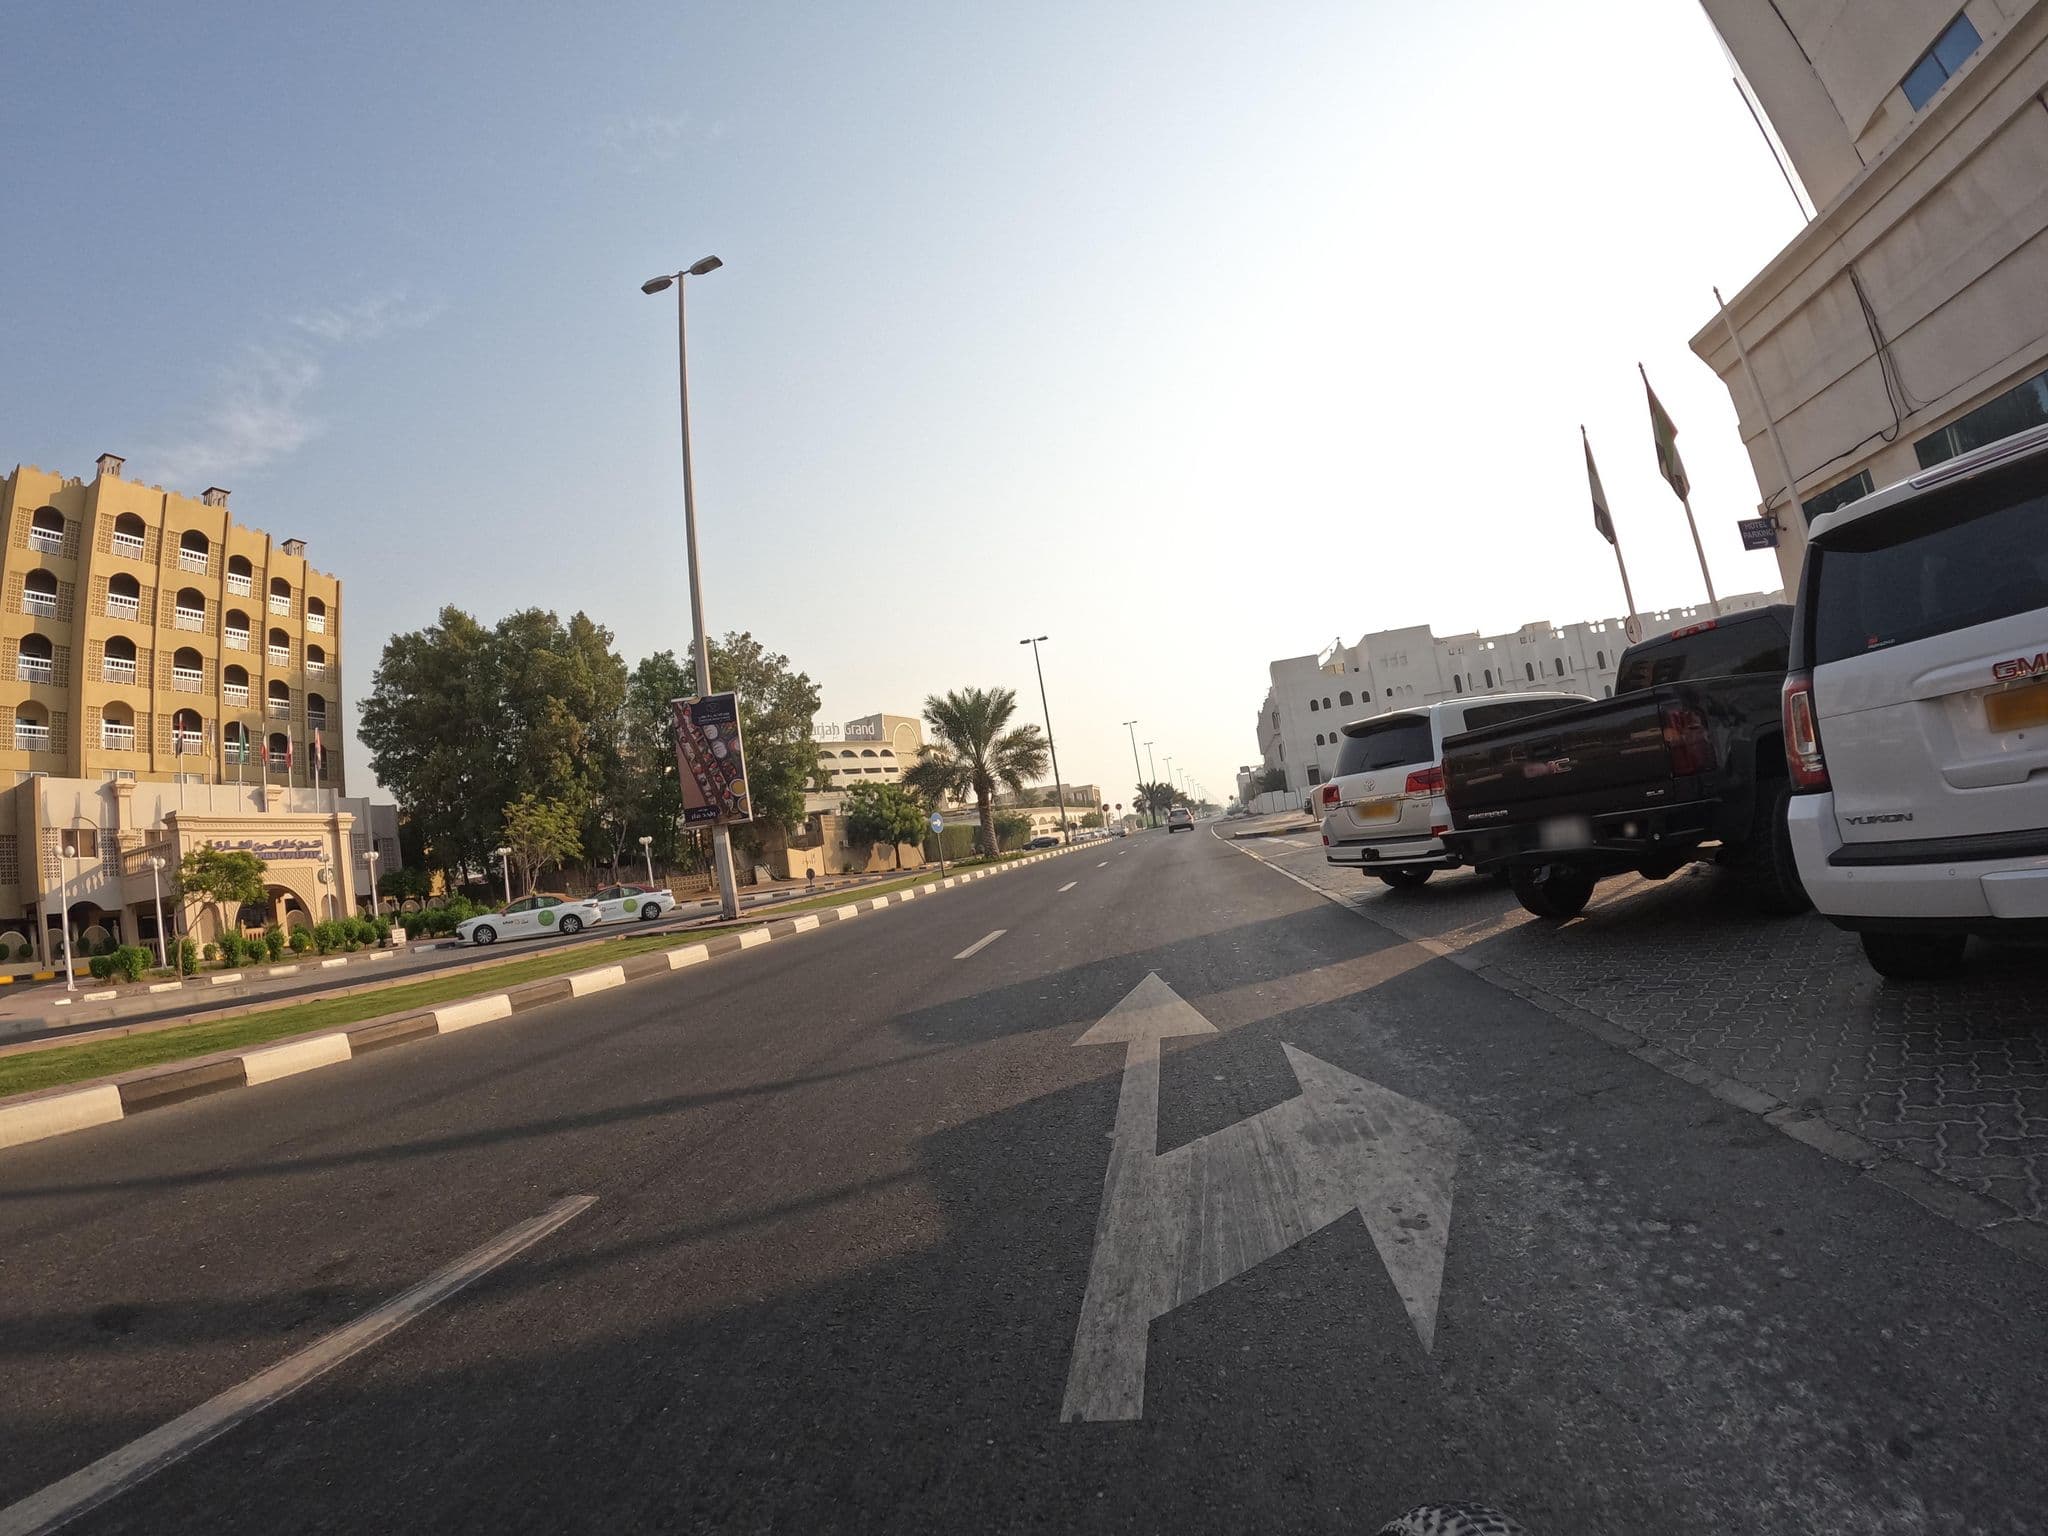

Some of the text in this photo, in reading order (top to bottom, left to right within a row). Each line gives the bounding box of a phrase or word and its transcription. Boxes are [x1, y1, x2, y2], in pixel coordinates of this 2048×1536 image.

[1742, 521, 1767, 531] HOTEL
[1743, 528, 1774, 539] PARKING
[1992, 652, 2048, 680] GM
[845, 722, 875, 736] Grand
[1845, 813, 1913, 825] YUKON
